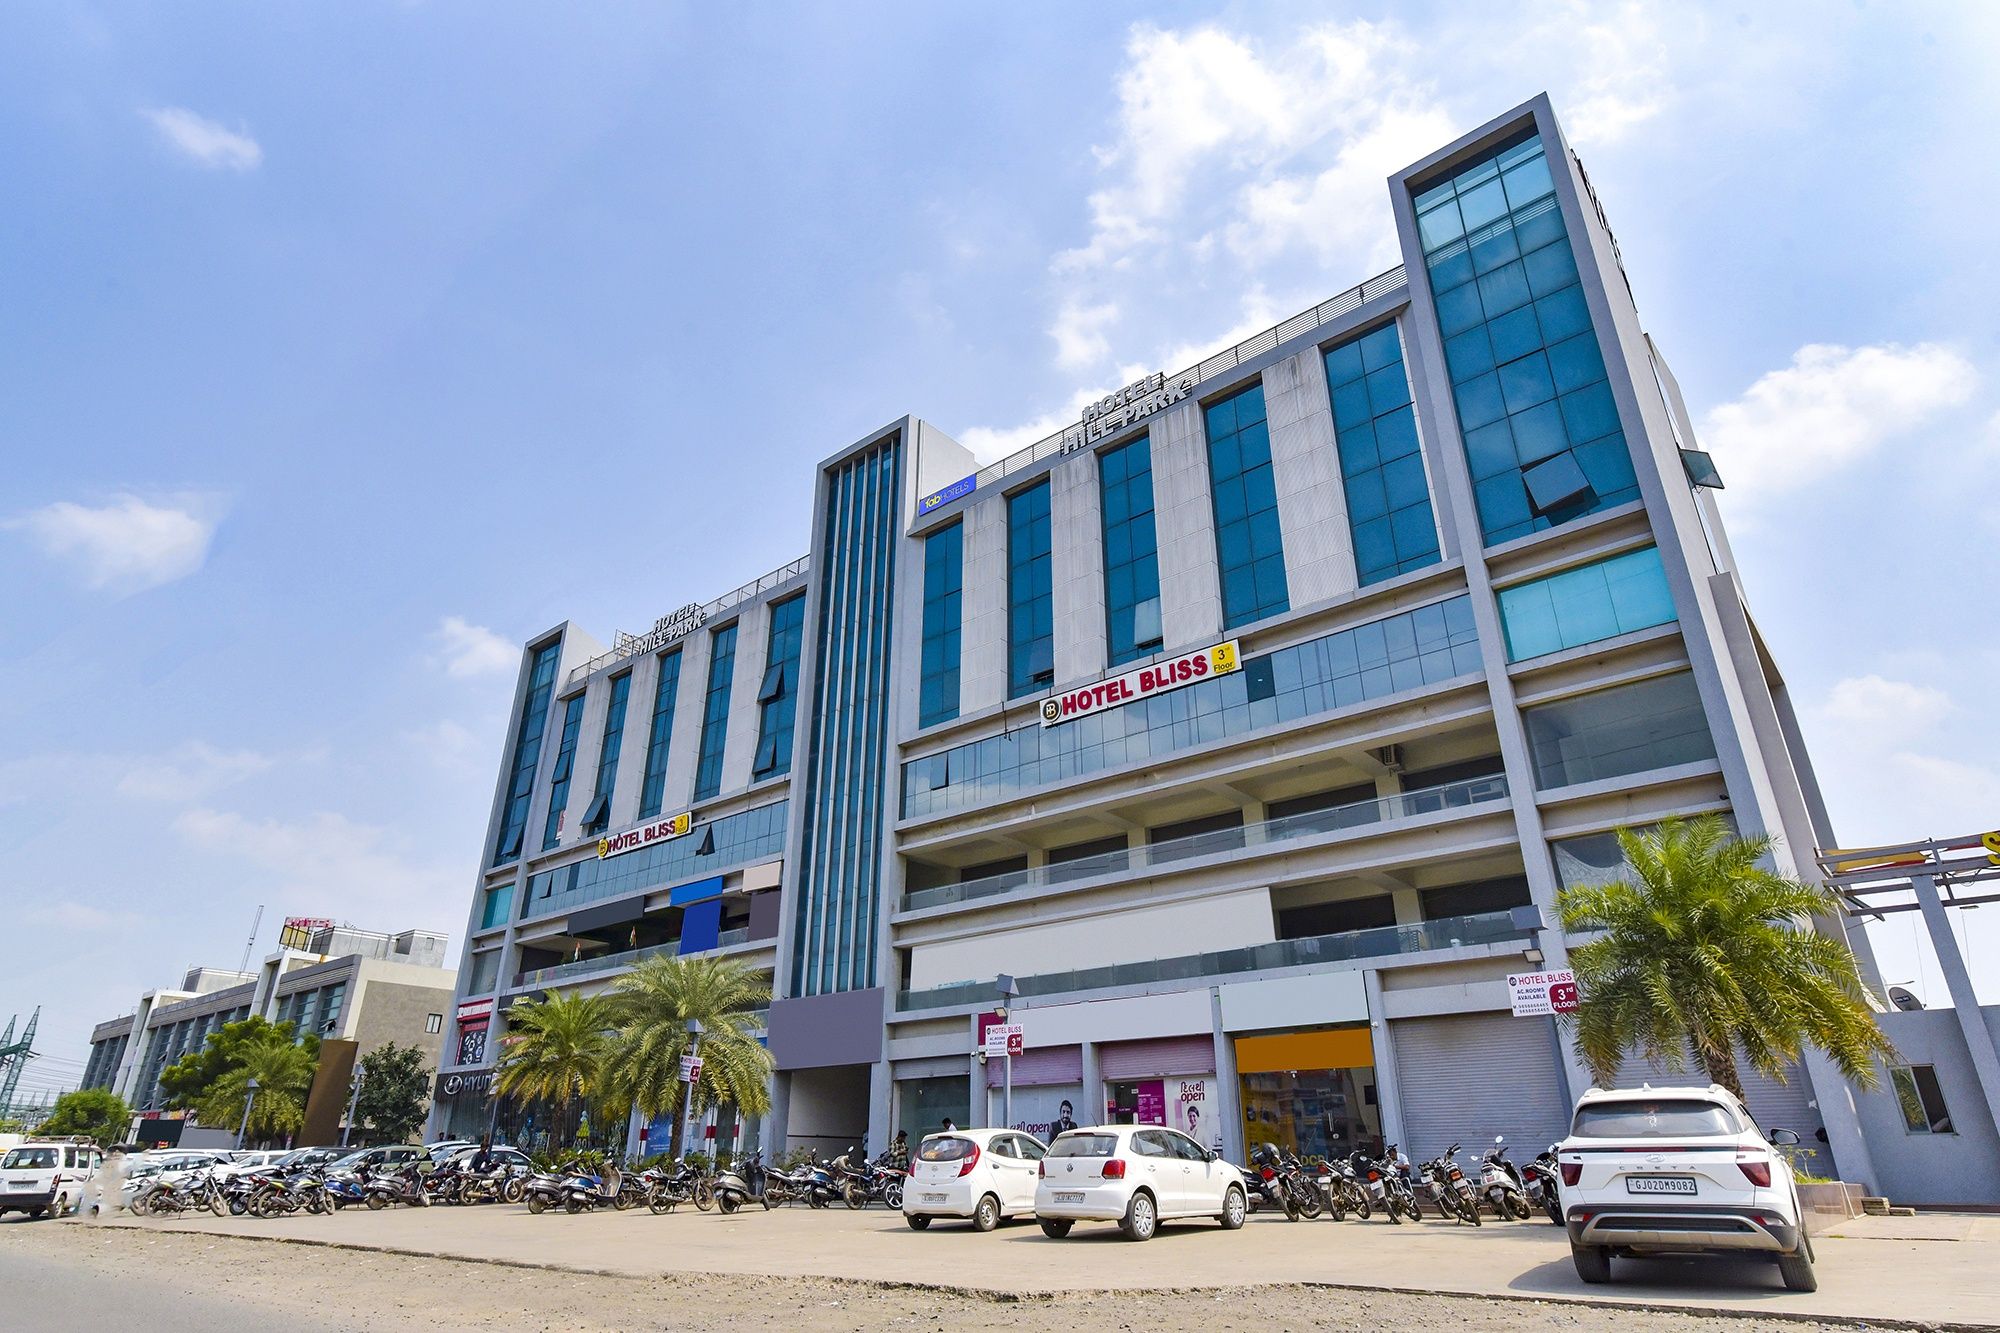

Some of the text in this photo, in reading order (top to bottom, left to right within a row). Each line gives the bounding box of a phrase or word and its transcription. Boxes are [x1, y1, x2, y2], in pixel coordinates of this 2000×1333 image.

[1083, 374, 1160, 425] HOTEL
[1062, 381, 1188, 456] HILL PARK
[653, 603, 694, 634] HOTEL
[640, 612, 704, 655] HILL PARK
[1213, 661, 1233, 672] Floor
[1062, 654, 1208, 715] HOTEL BLISS
[608, 820, 675, 852] HOTEL BLISS
[1518, 972, 1572, 985] HOTEL BLISS
[1553, 1001, 1577, 1009] FLOOR
[1008, 1025, 1021, 1033] BLISS
[464, 1074, 491, 1091] HYUN
[1181, 1092, 1205, 1104] open
[1027, 1122, 1049, 1135] open
[1635, 1180, 1694, 1191] GJ02DM9082
